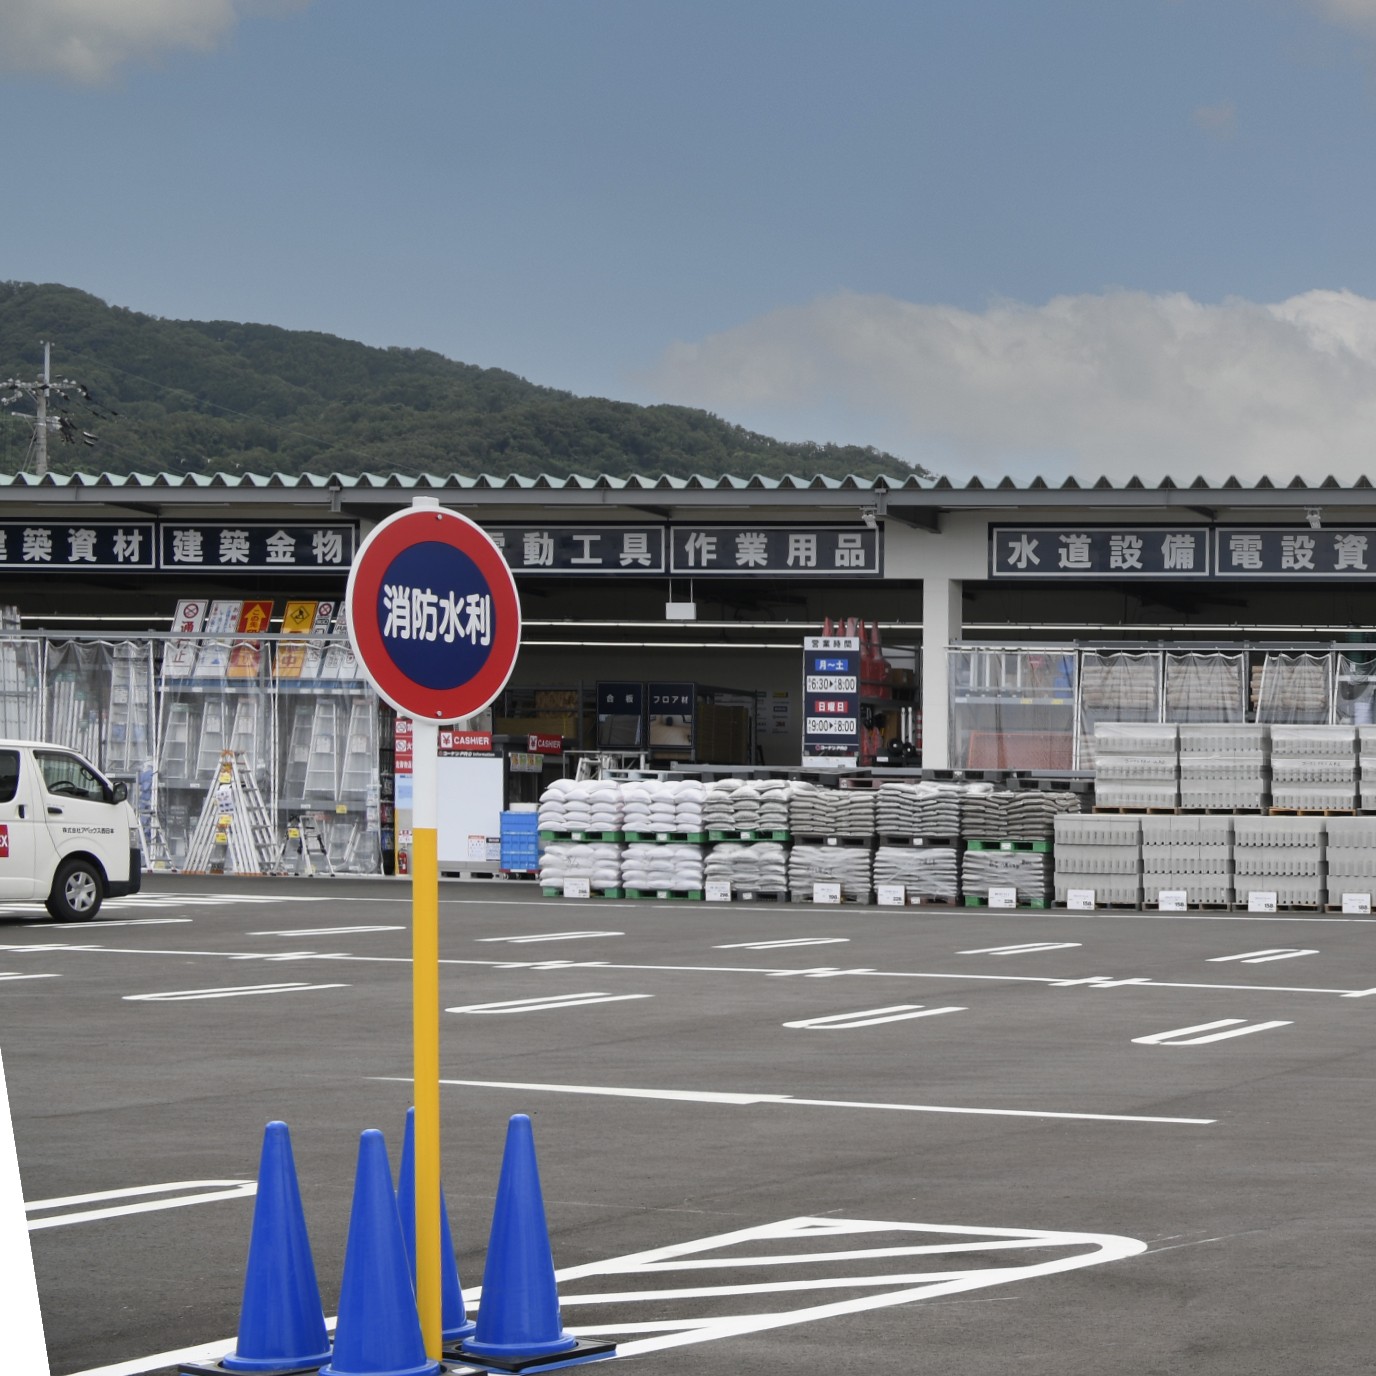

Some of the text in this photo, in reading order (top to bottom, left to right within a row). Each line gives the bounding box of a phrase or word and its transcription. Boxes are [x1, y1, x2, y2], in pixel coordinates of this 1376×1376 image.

[0, 528, 143, 563] 築資材
[172, 529, 344, 564] 建築金物
[492, 532, 652, 568] 動工具
[684, 532, 866, 568] 作業用品
[1007, 534, 1196, 570] 水道設備
[383, 584, 491, 645] 消防水利
[811, 639, 853, 649] 営業時間
[811, 677, 856, 691] 6:30 8:00
[453, 736, 490, 746] CASHIER
[811, 719, 855, 732] 9:00 8:00
[537, 739, 561, 749] CASHIER
